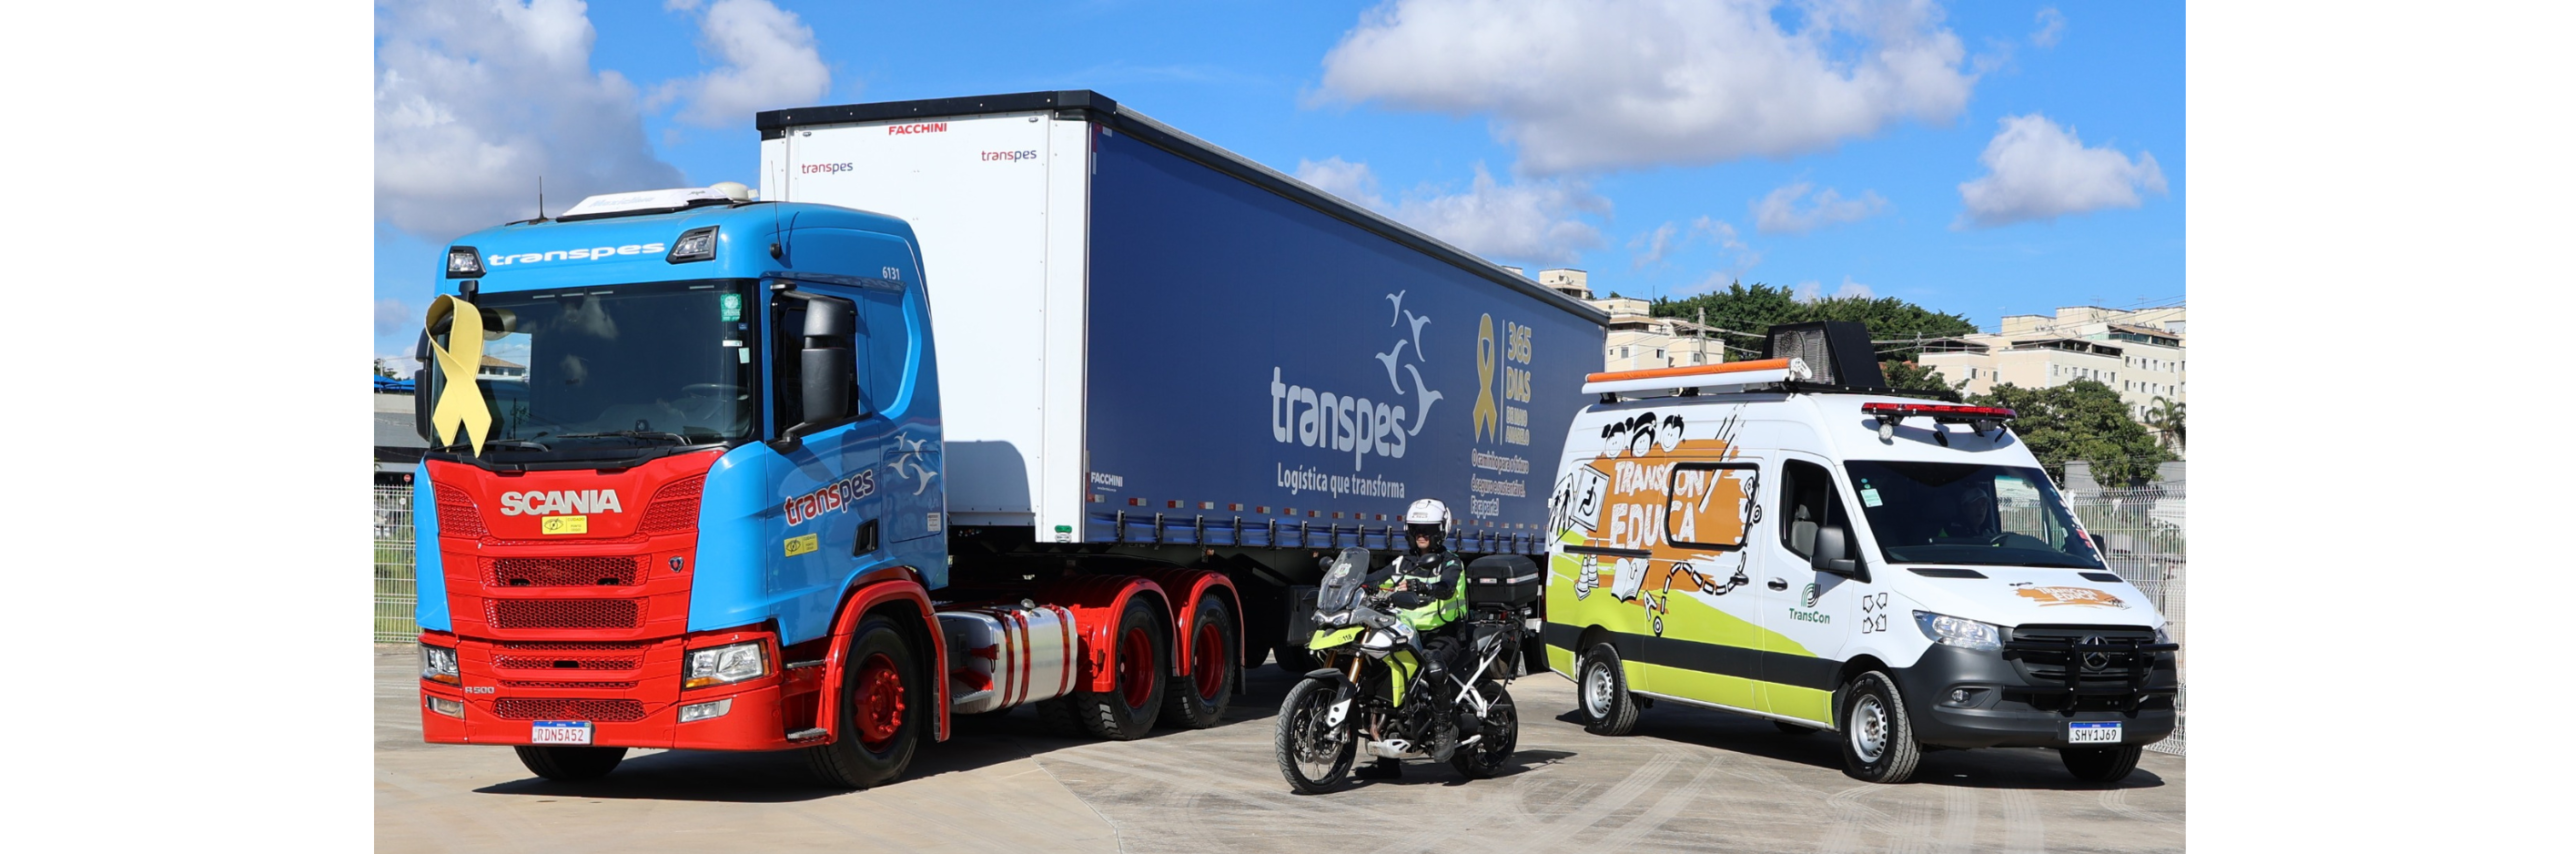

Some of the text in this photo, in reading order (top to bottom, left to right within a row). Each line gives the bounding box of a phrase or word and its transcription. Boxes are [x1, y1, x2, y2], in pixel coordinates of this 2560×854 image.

[888, 123, 947, 135] FACCHINI
[981, 150, 1038, 163] transpes
[802, 162, 853, 175] transpes
[488, 243, 665, 266] transpes
[882, 266, 900, 280] 6131
[1507, 321, 1532, 365] 365
[1506, 366, 1531, 403] DIAS
[1271, 366, 1406, 472] transpes
[1091, 472, 1123, 487] FACCHINI
[1277, 462, 1405, 499] Logística que transforma
[1613, 461, 1705, 498] TRANSCON
[500, 489, 623, 516] SCANIA
[784, 469, 875, 527] transpes
[1609, 500, 1696, 549] EDUCA
[1789, 608, 1830, 624] TransCon
[464, 686, 495, 694] R 500
[537, 728, 584, 742] RDN5A52
[2075, 729, 2117, 741] SHY1J69
